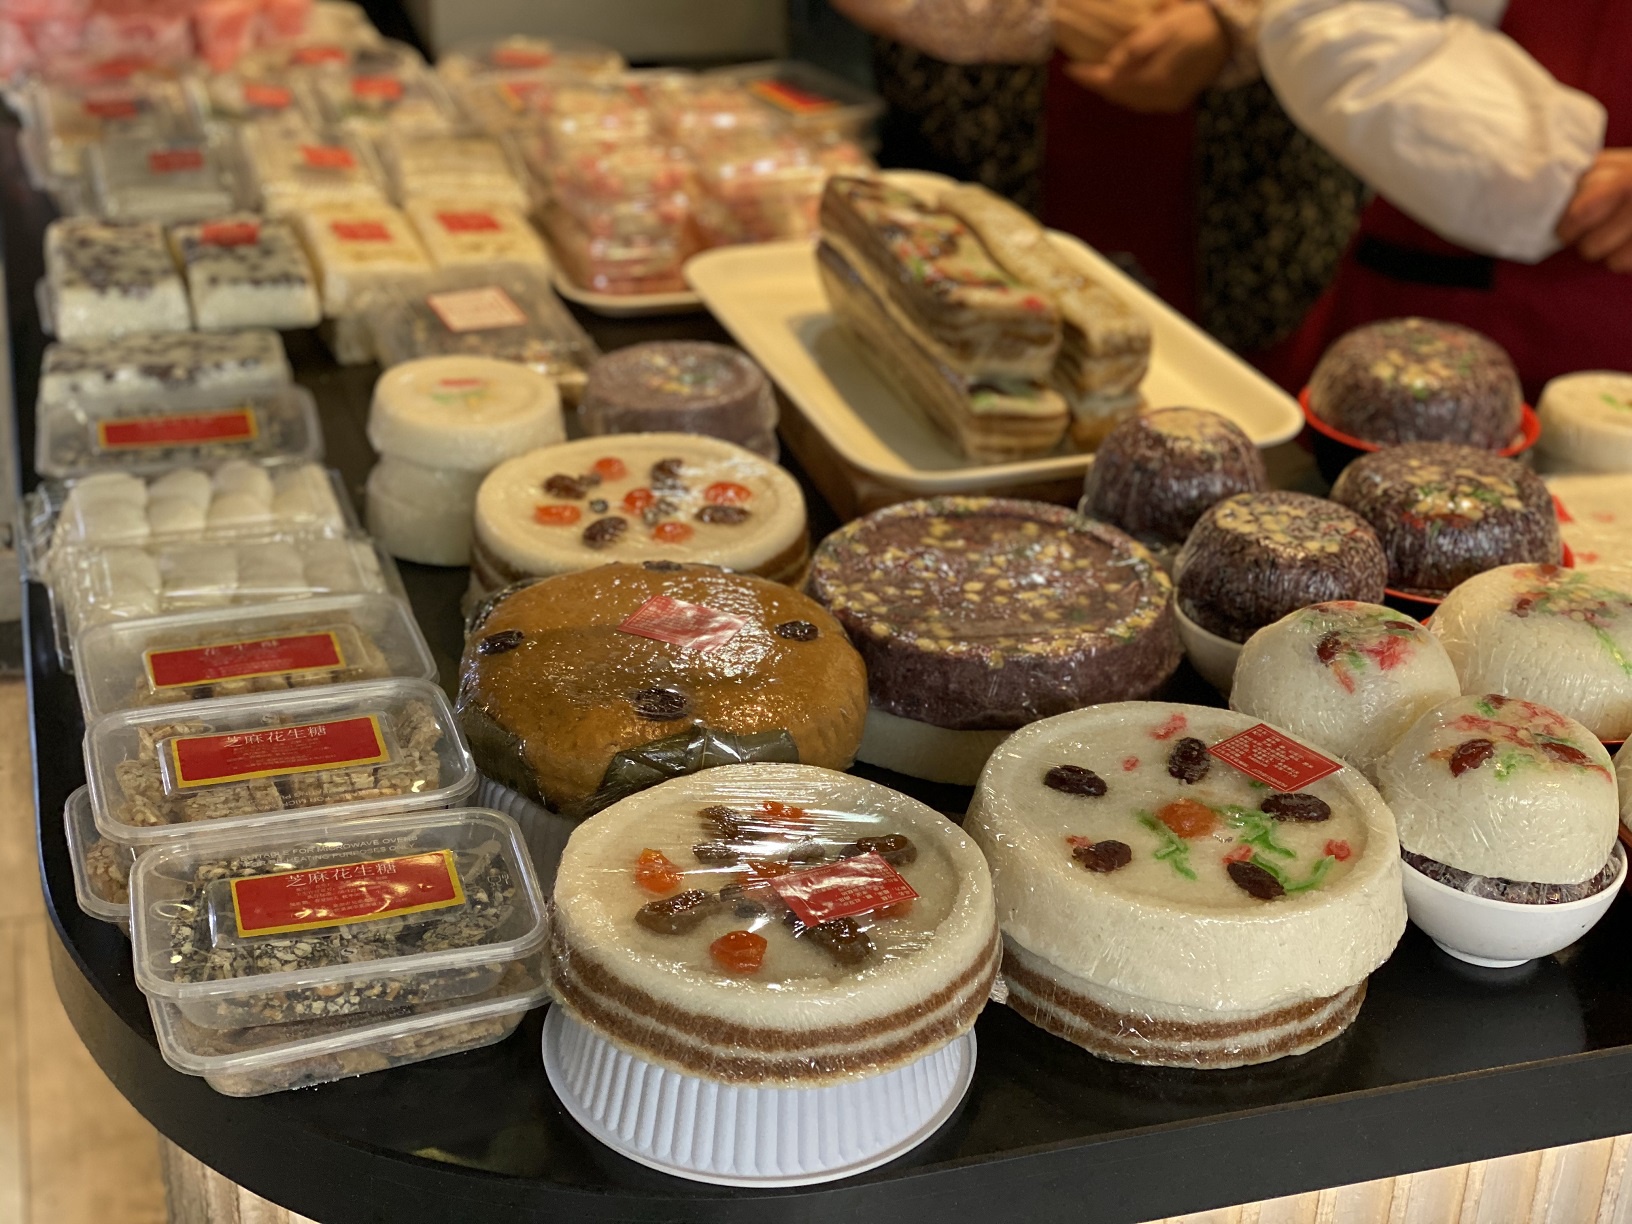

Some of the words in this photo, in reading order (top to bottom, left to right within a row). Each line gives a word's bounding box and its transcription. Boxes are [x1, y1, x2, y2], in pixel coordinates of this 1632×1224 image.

[224, 725, 327, 747] 芝麻花生糖
[293, 846, 315, 855] FOR
[316, 839, 379, 853] MICROWAVE
[333, 845, 387, 859] PURPOSES
[286, 861, 397, 887] 芝麻花生糖
